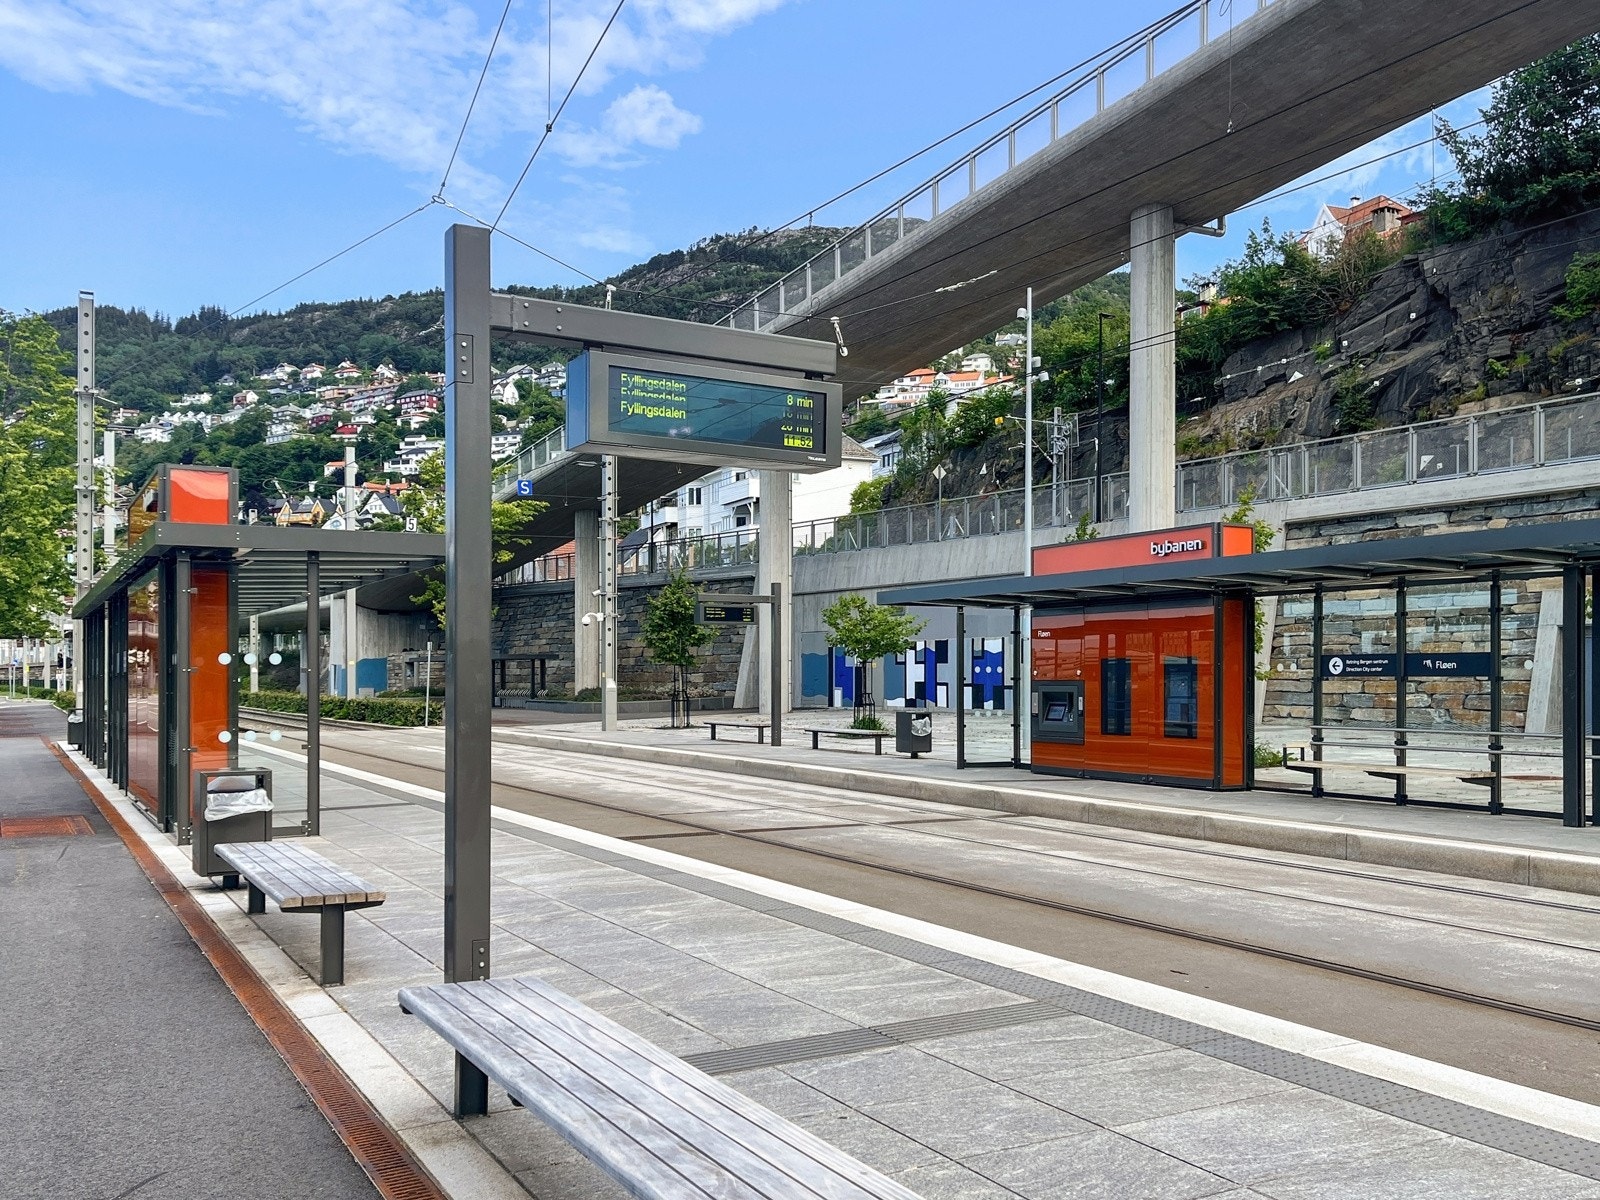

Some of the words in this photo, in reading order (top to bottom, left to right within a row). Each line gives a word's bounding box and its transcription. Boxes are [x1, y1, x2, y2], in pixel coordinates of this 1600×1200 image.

[620, 373, 686, 392] Fyllingsdalen
[787, 394, 794, 406] 8
[796, 397, 813, 408] min
[620, 400, 686, 419] Fyllingsdalen
[784, 434, 812, 448] 11:52
[520, 481, 530, 495] S
[408, 518, 415, 531] 5
[1150, 539, 1202, 557] bybanen
[1435, 660, 1457, 669] Fløen
